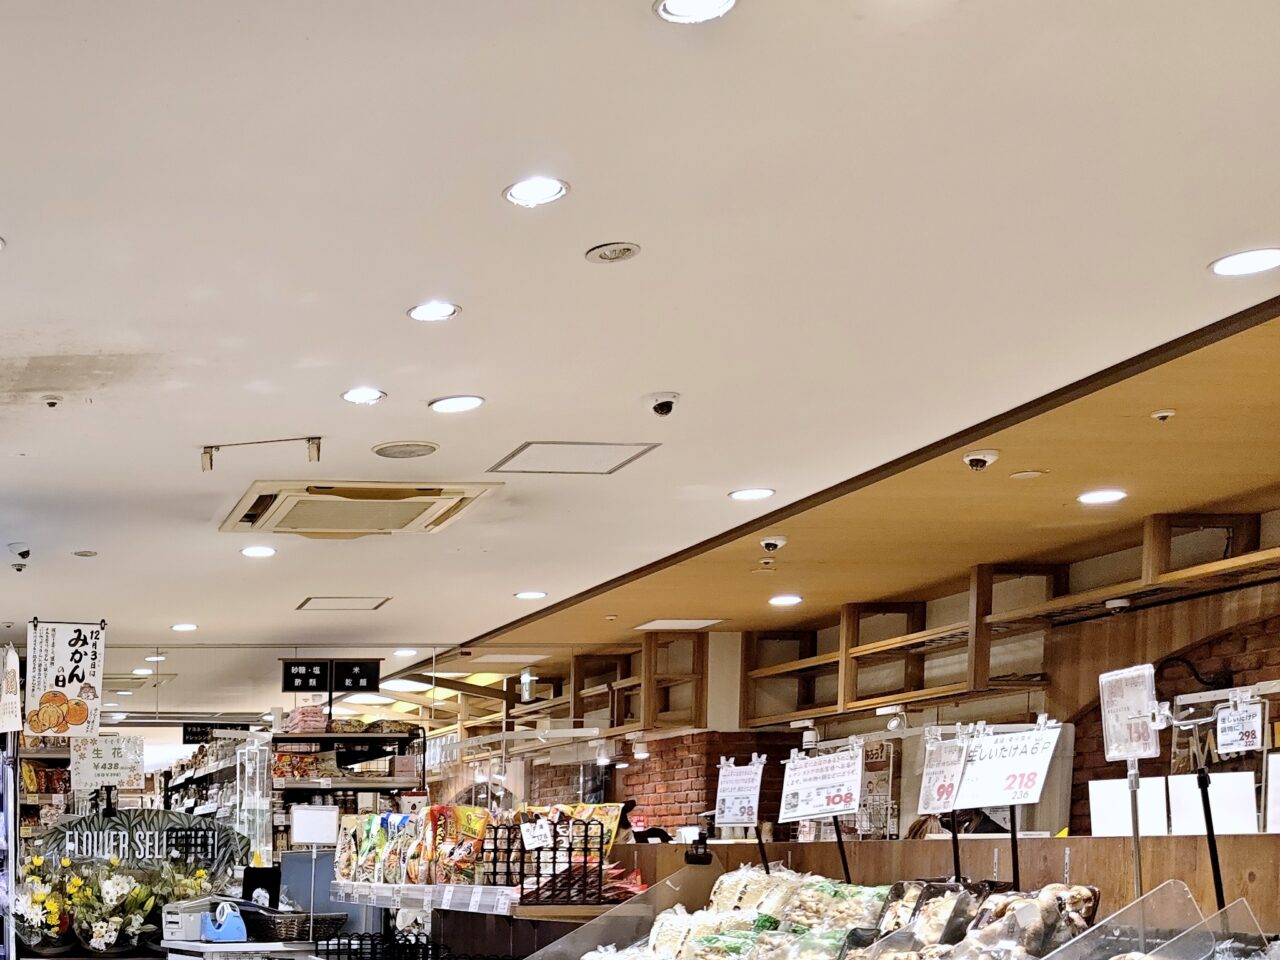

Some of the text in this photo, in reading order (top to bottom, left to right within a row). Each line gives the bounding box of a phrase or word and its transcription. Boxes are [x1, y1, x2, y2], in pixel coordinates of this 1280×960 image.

[67, 628, 89, 684] みかん
[352, 666, 360, 674] 米
[1239, 730, 1257, 742] 298
[92, 747, 123, 759] 生花
[1004, 772, 1038, 791] 218
[825, 793, 854, 806] 108
[739, 805, 754, 816] 98
[66, 830, 129, 859] FLOWER
